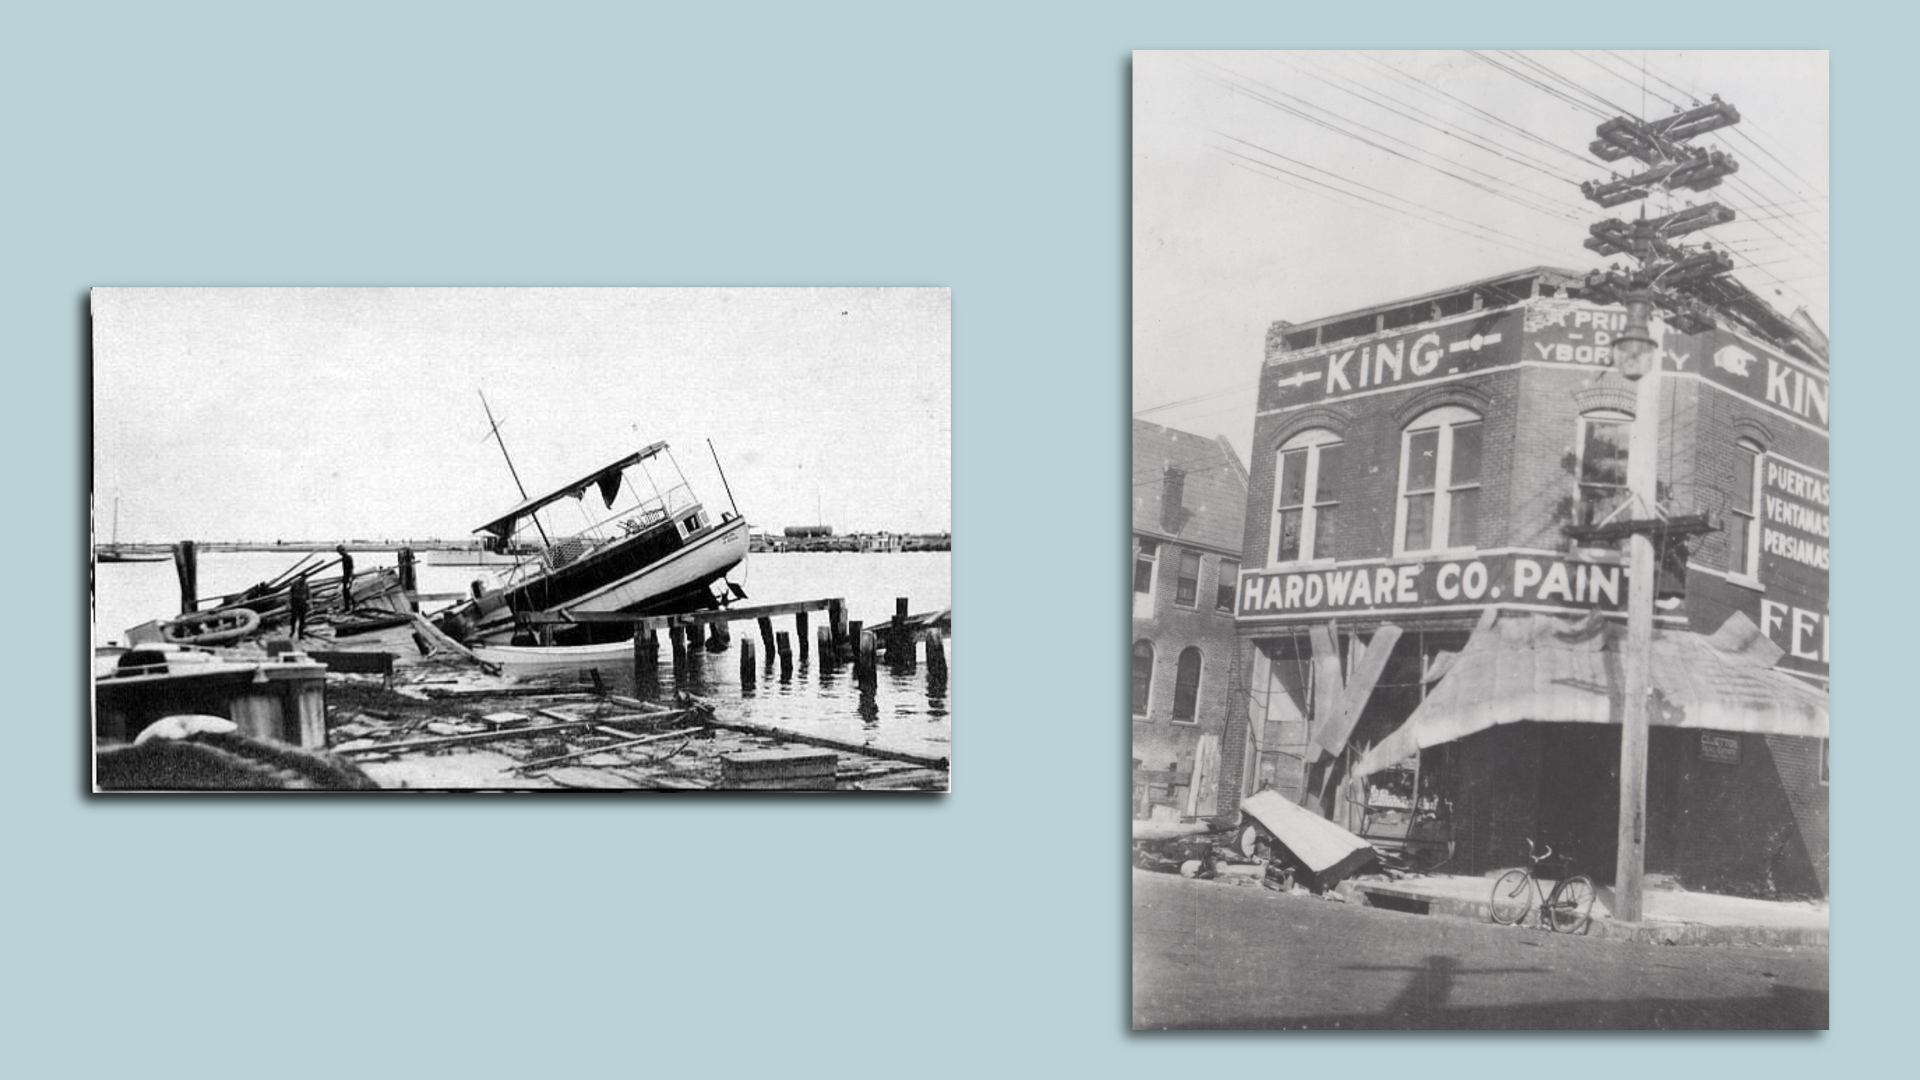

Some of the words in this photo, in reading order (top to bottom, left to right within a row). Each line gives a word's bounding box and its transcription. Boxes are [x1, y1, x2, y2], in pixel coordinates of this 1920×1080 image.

[1326, 332, 1443, 394] KING
[1534, 341, 1611, 364] YBOR
[1768, 461, 1829, 507] PUERTAS
[1766, 494, 1829, 539] VENTANAS
[1764, 528, 1829, 570] PERSIANAS
[1242, 563, 1419, 611] HARDWARE
[1435, 560, 1501, 600] CO.
[1513, 559, 1680, 609] PAIN
